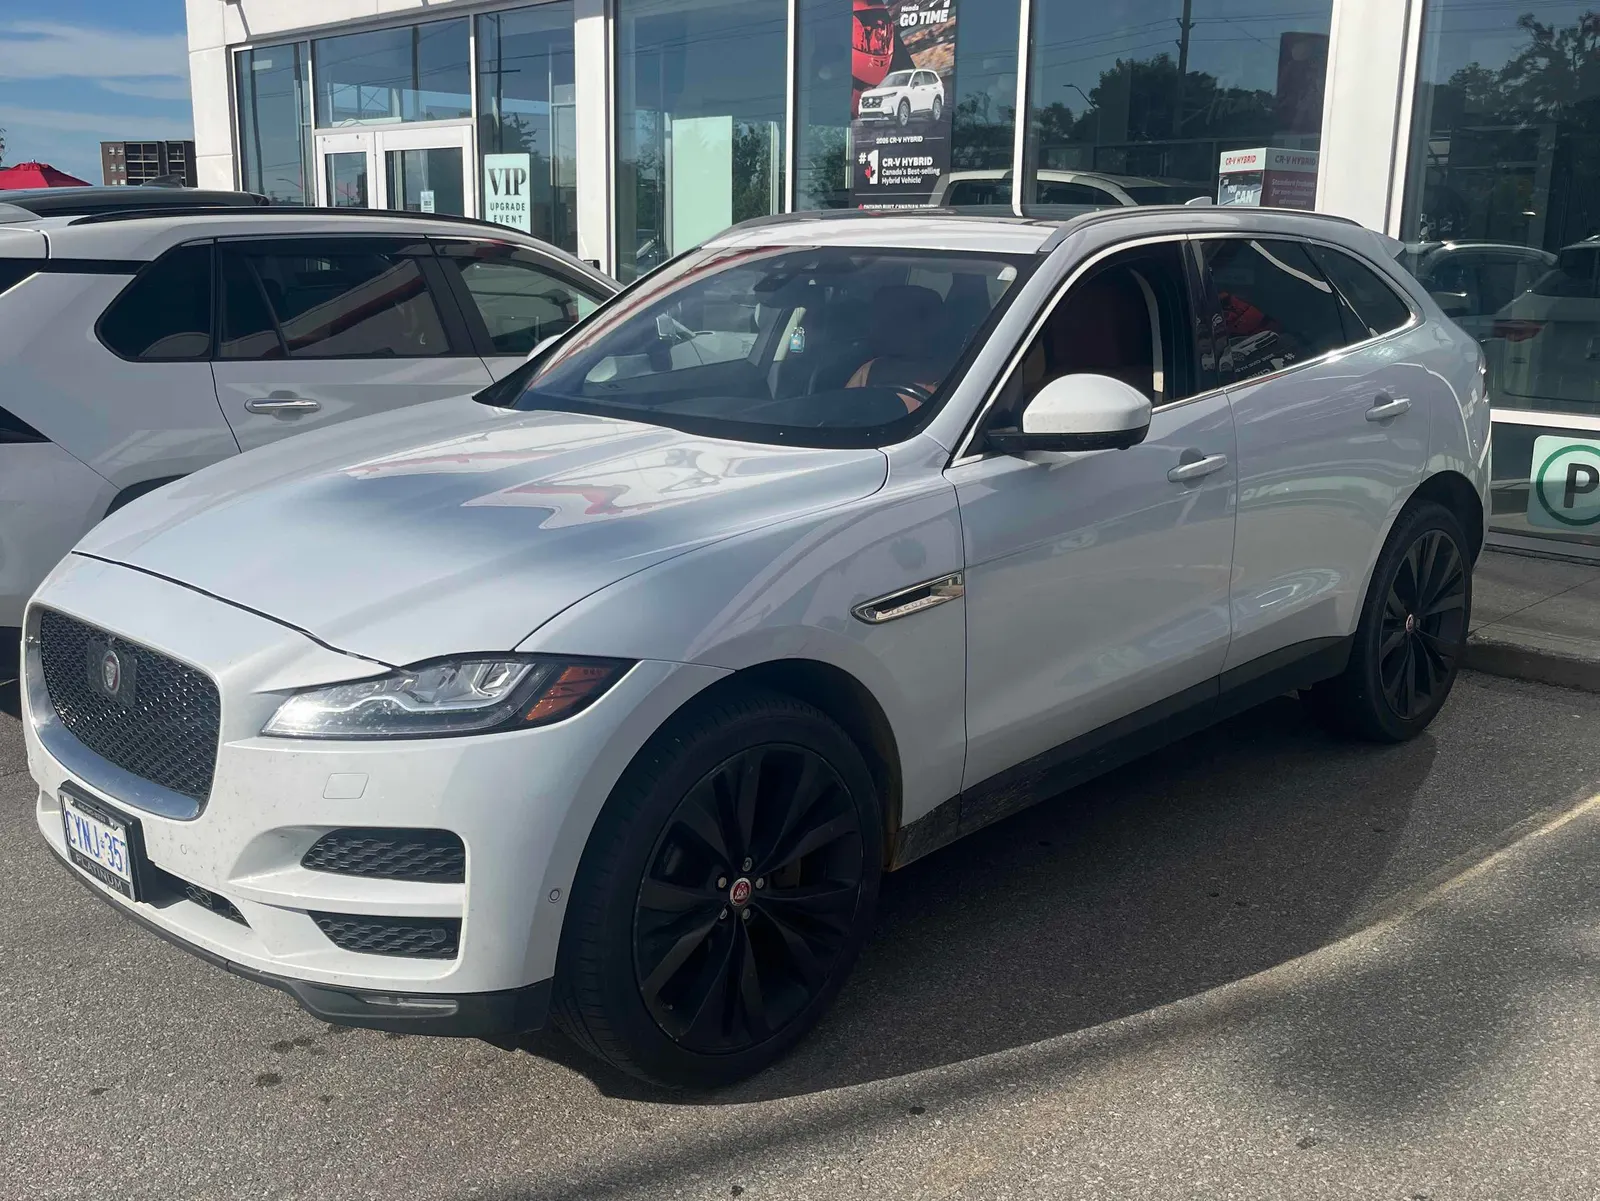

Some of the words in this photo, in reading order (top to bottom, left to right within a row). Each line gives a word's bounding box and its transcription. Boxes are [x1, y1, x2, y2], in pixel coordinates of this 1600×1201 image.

[900, 12, 918, 27] GO
[919, 9, 949, 25] TIME
[889, 136, 903, 144] CR-V
[903, 135, 923, 143] HYBRID
[882, 157, 901, 167] CR-V
[902, 156, 933, 167] HYBRID
[1225, 157, 1237, 166] CR-V
[1237, 155, 1257, 165] HYBRID
[1274, 155, 1291, 164] CR-V
[1291, 156, 1316, 166] HYBRID
[881, 168, 906, 176] Canada's
[907, 167, 940, 176] Best-selling
[487, 167, 527, 196] VIP
[881, 177, 900, 186] Hybrid
[1234, 190, 1254, 204] CAN
[489, 202, 525, 211] UPGRADE
[493, 214, 523, 224] EVENT
[1563, 462, 1600, 509] P
[65, 810, 100, 859] CYNJ
[75, 853, 124, 892] PLATINUM
